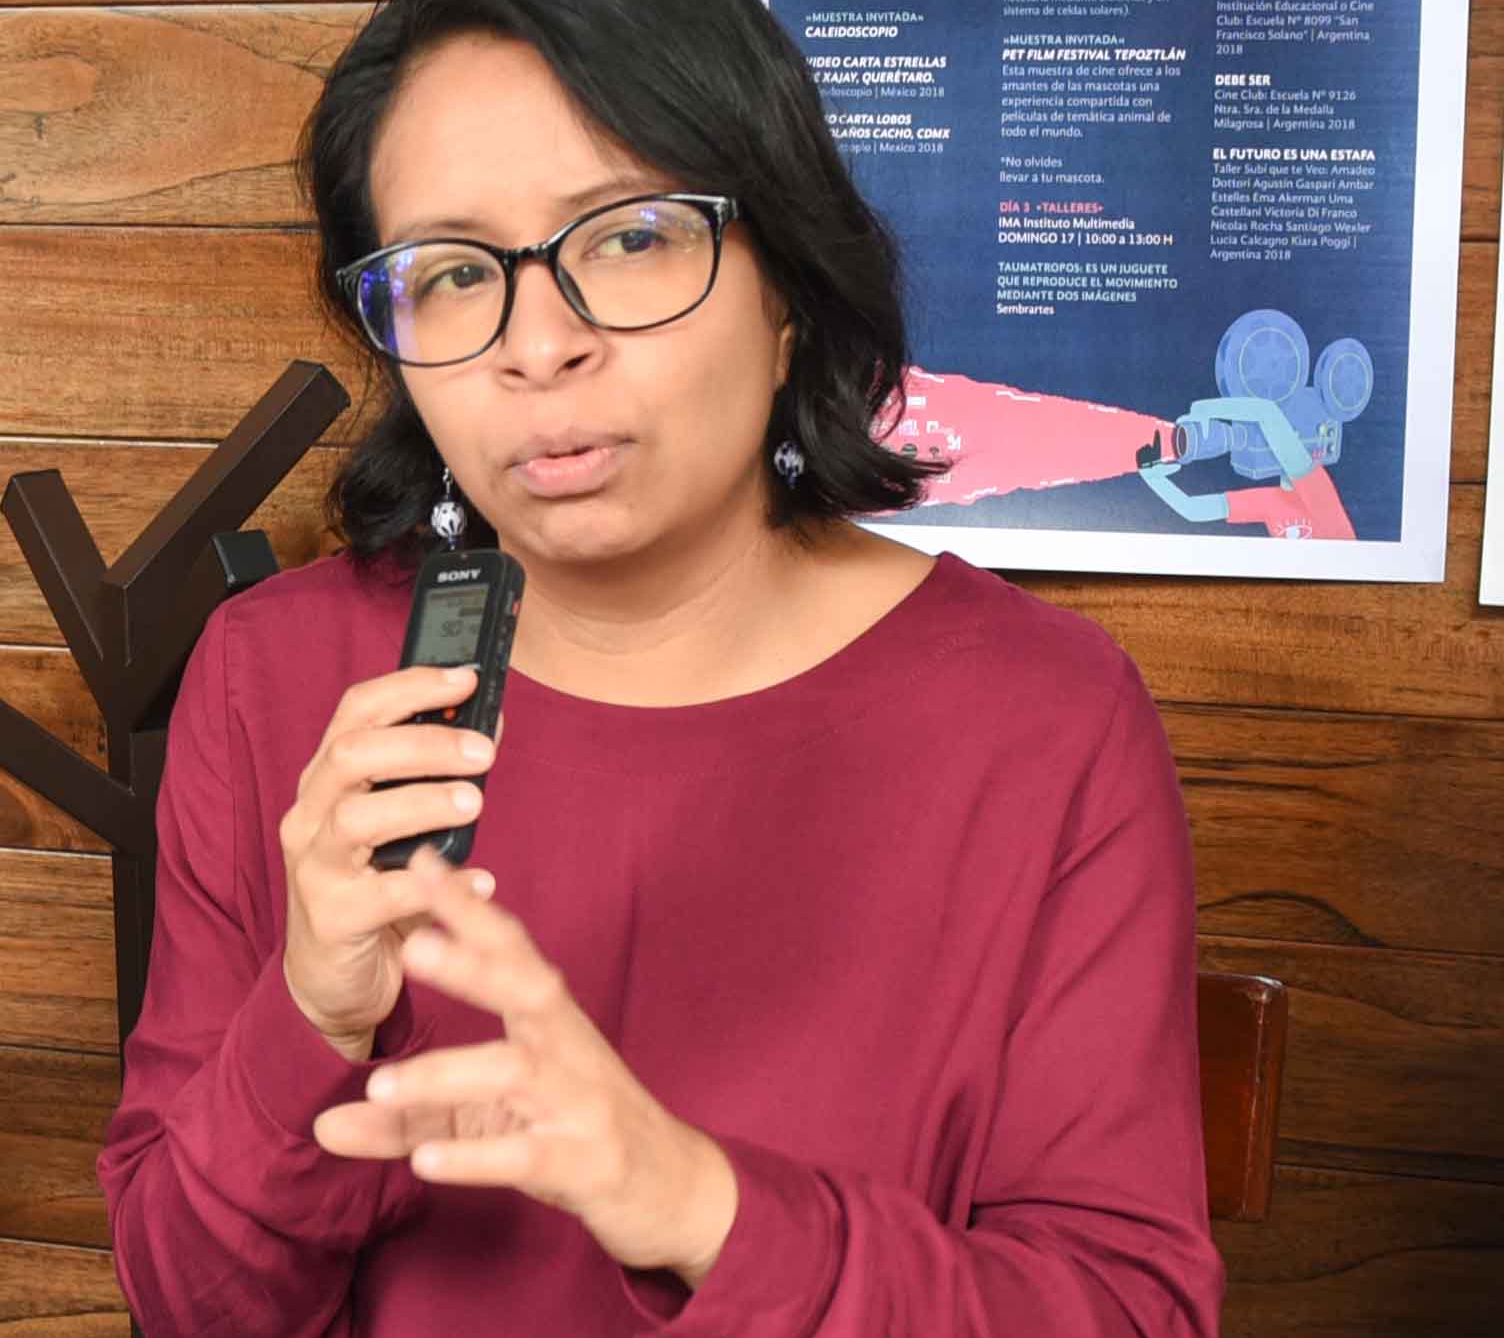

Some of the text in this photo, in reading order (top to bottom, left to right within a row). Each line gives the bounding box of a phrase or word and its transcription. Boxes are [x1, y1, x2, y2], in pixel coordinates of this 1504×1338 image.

[805, 26, 898, 38] CALEIDOSCOPIO
[1002, 46, 1187, 60] PET FILM FESTIVAL TEPOZTLÁN
[1215, 74, 1272, 86] DEBE SER
[1001, 96, 1153, 109] experiencia compartida con
[1212, 148, 1376, 161] EL FUTURO ES UNA ESTAFA
[998, 217, 1135, 229] IMA Instituto Multimedia
[998, 232, 1174, 245] DOMINGO 17 10:00 a 13:00 H
[996, 289, 1137, 302] MEDIANTE DOS IMÁGENES
[436, 568, 481, 583] SONY
